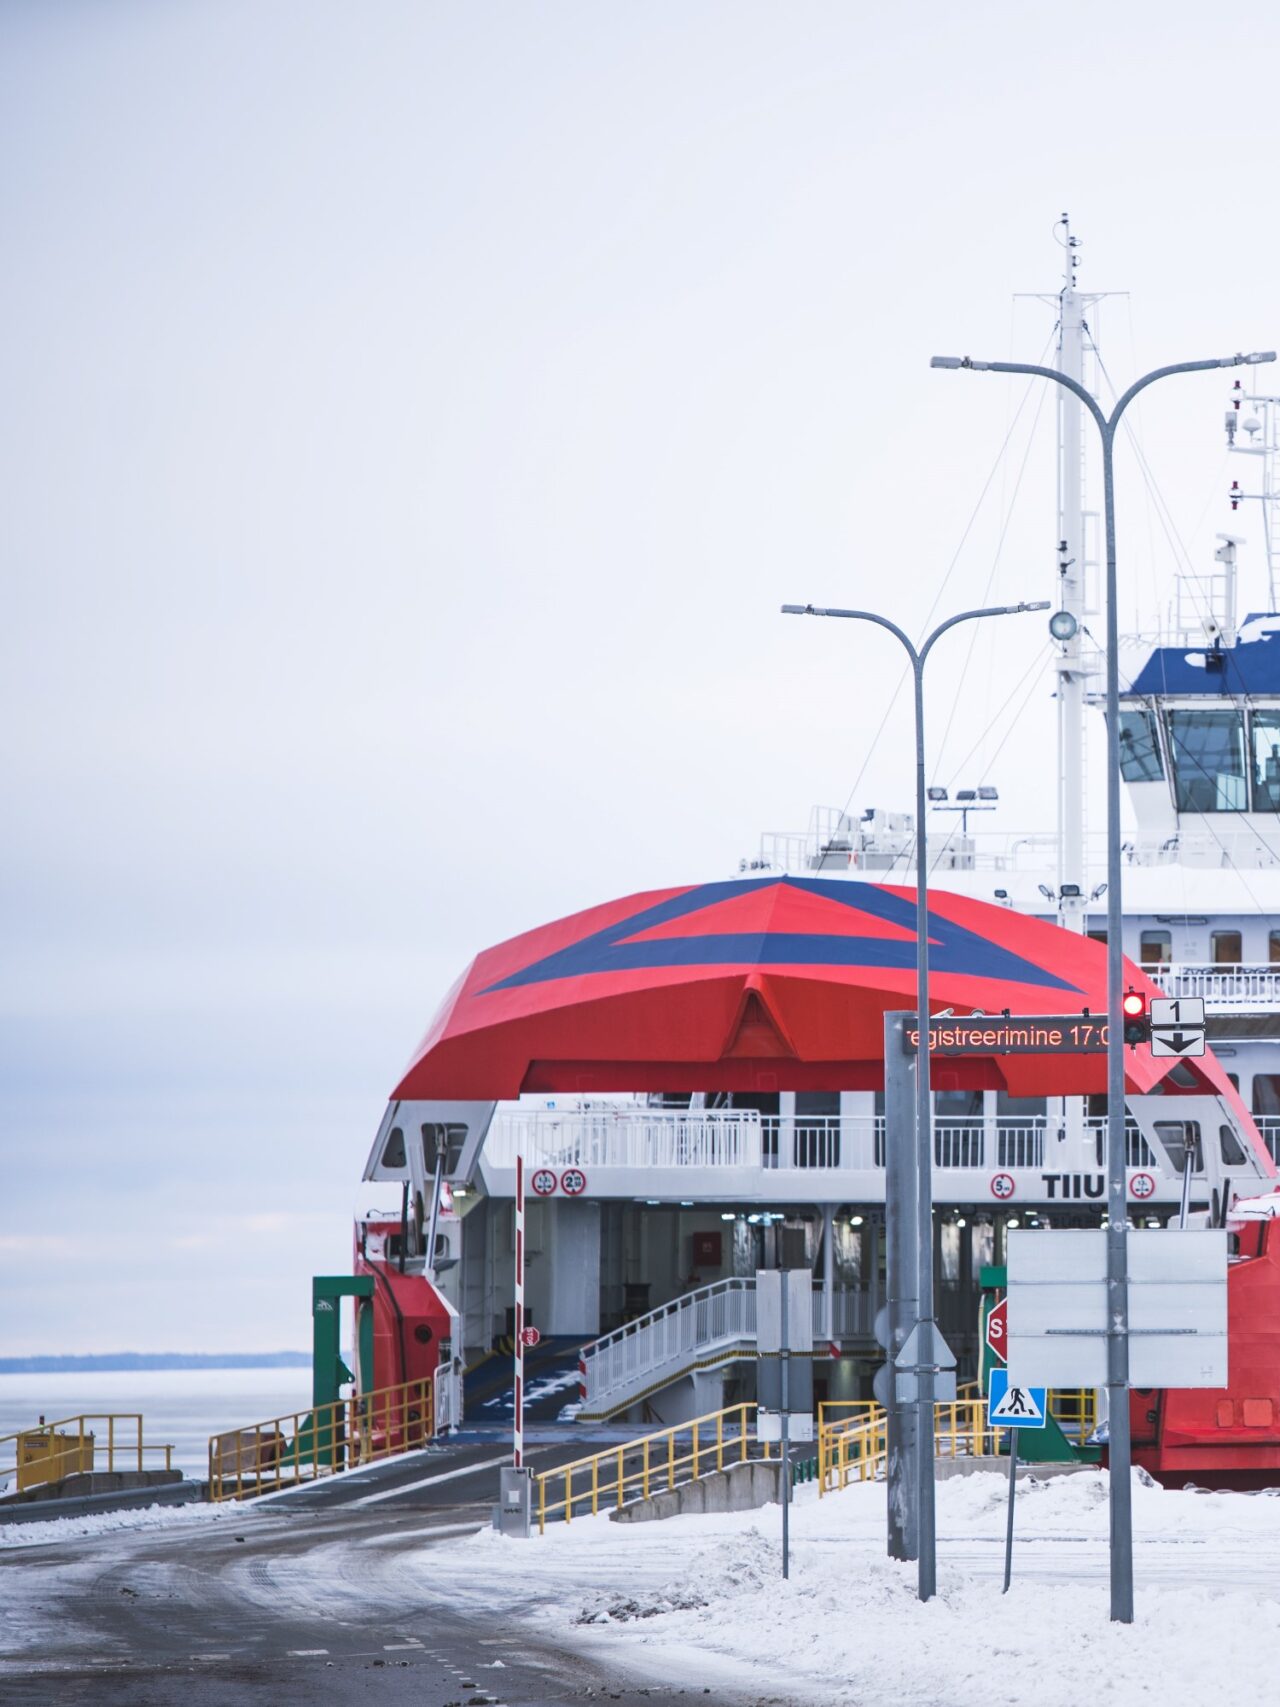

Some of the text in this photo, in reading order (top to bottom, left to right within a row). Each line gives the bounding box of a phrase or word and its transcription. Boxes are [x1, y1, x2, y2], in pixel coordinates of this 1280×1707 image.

[1170, 1001, 1180, 1022] 1
[906, 1025, 1062, 1050] egistreerimine
[1042, 1174, 1104, 1198] TIIU
